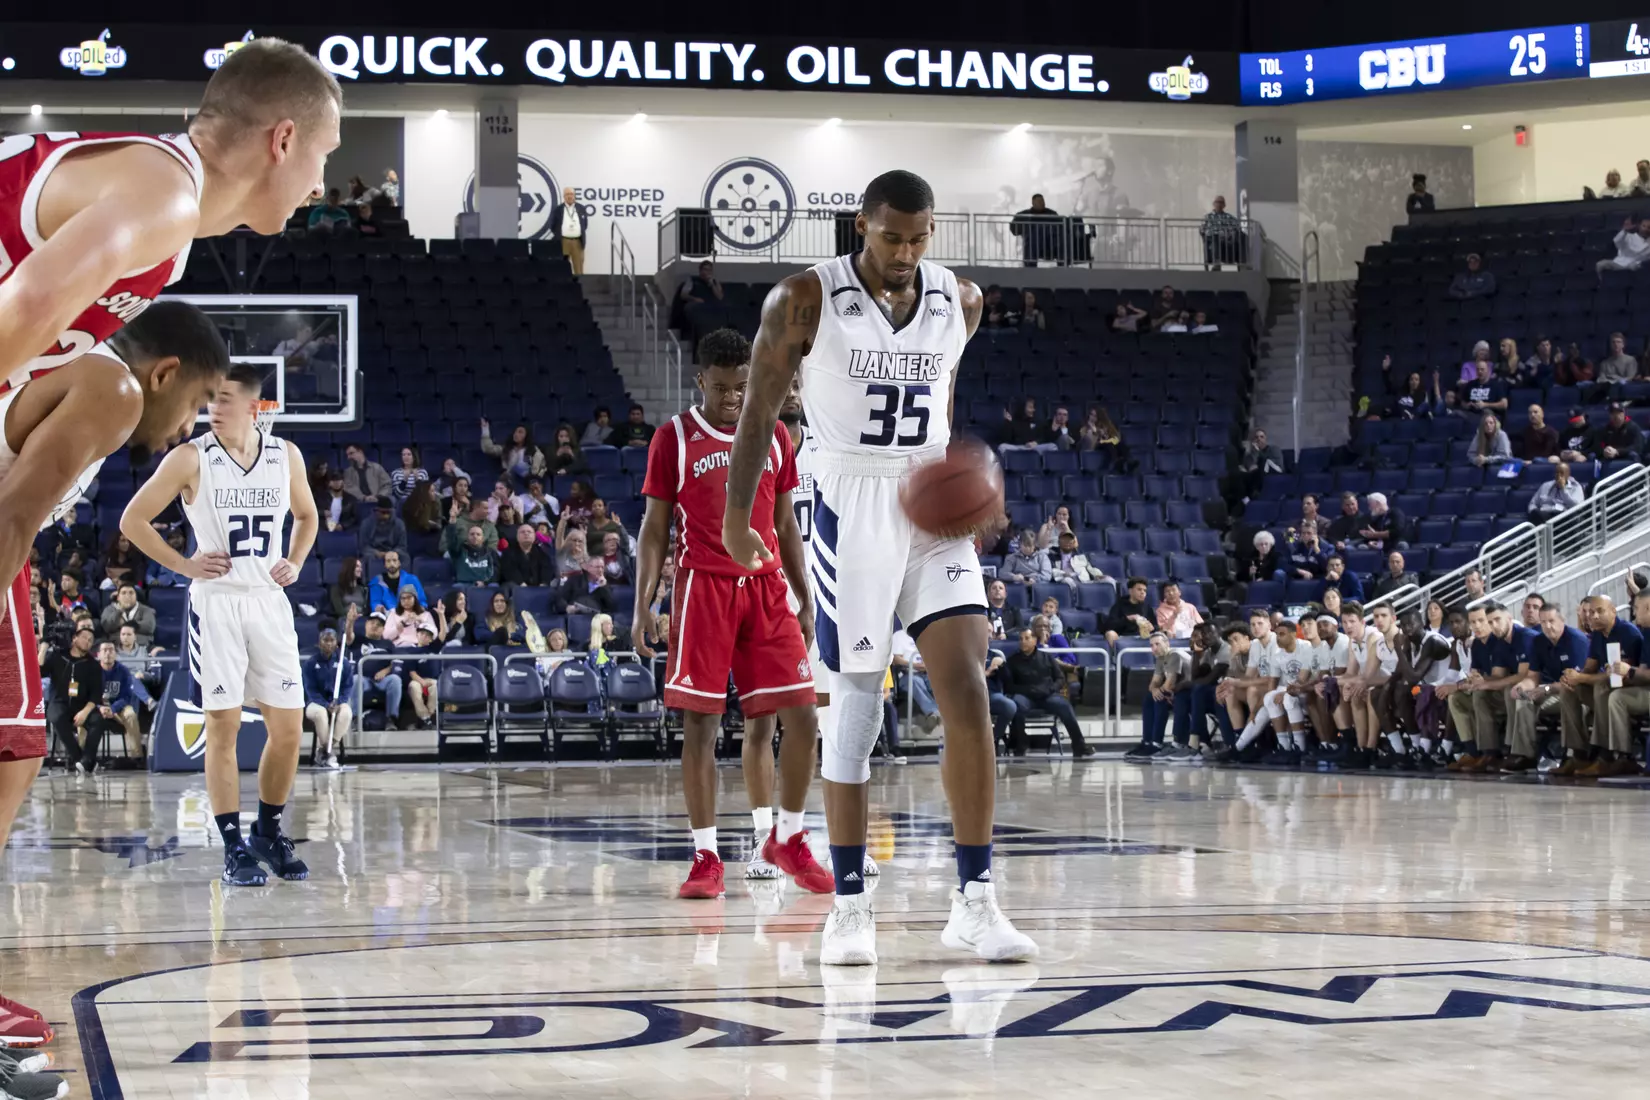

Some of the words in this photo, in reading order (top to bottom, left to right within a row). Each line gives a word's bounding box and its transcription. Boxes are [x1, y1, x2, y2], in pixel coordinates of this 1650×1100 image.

[1625, 23, 1650, 55] 4:
[319, 35, 504, 79] QUICK.
[525, 38, 765, 83] QUALITY.
[786, 45, 870, 85] OIL
[884, 48, 1110, 93] CHANGE.
[1258, 58, 1283, 75] TOL
[1305, 53, 1313, 72] 3
[1509, 32, 1546, 76] 25
[1359, 43, 1446, 91] CBU
[1260, 82, 1282, 98] FLS
[1306, 77, 1314, 96] 3
[489, 116, 508, 125] 113
[490, 126, 507, 134] 114
[1264, 136, 1282, 145] 114
[574, 187, 664, 201] EQUIPPED
[602, 204, 662, 217] SERVE
[849, 349, 943, 381] LANCERS
[860, 384, 931, 446] 35
[693, 450, 730, 478] SOUTH
[215, 488, 280, 508] LANCERS
[228, 515, 274, 558] 25
